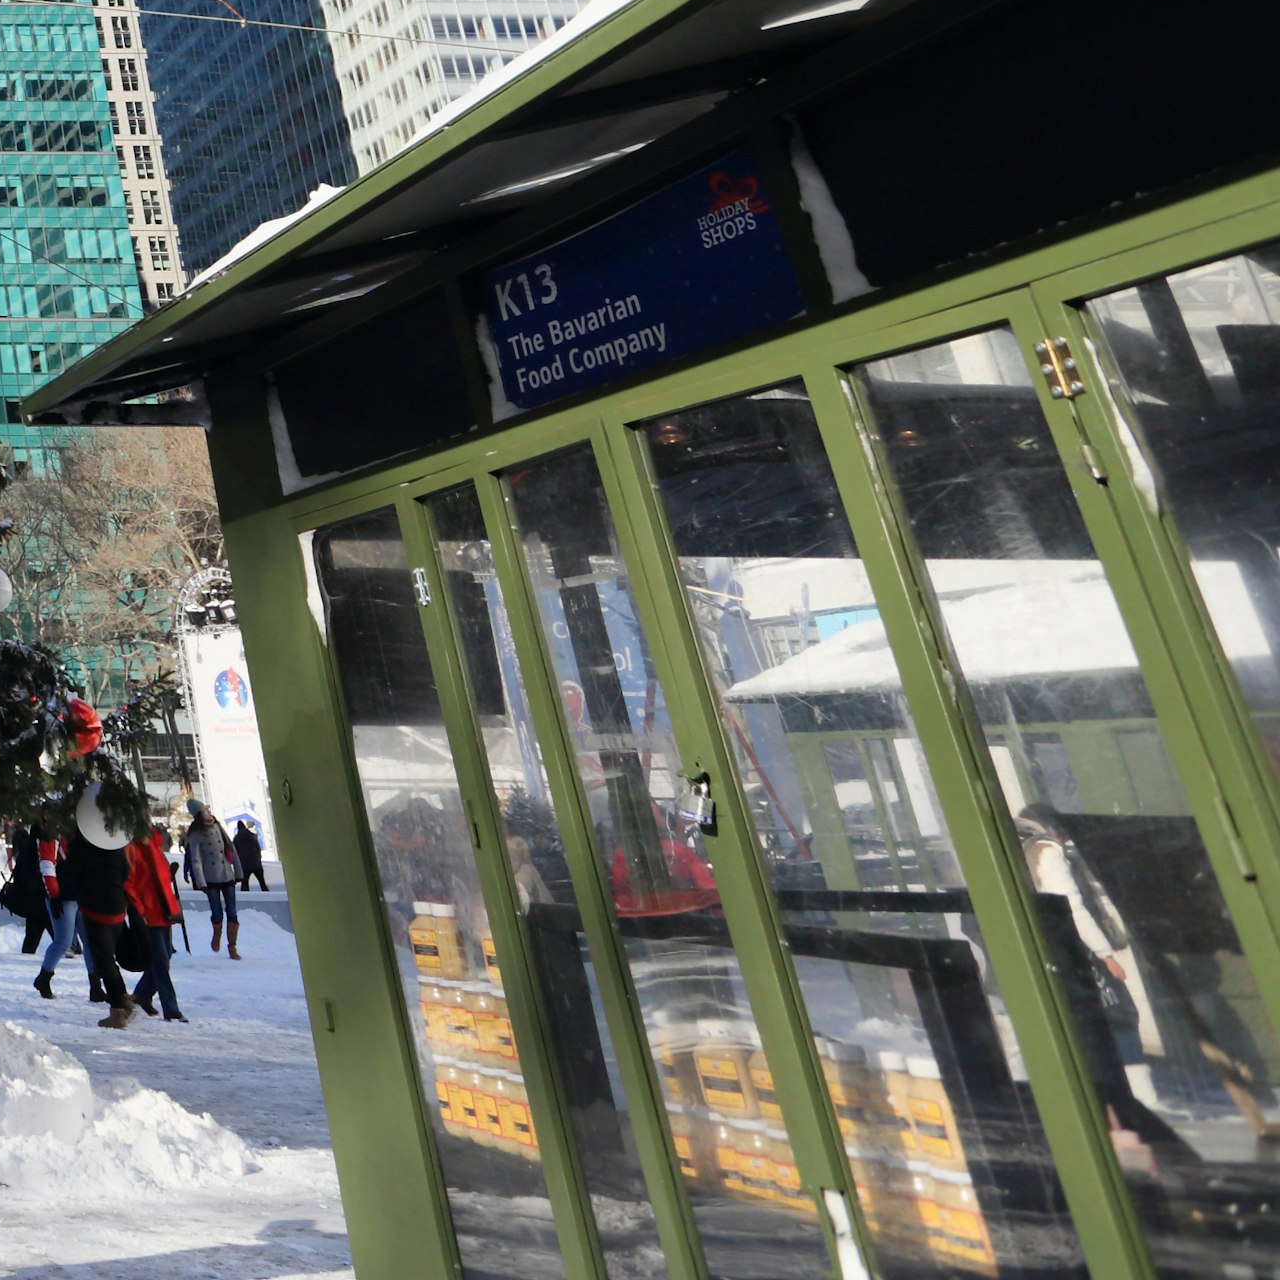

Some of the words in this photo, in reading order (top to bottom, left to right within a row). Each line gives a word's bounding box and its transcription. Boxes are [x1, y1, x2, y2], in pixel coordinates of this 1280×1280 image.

[696, 196, 752, 231] HOLIDAY
[701, 212, 757, 249] SHOPS
[495, 263, 559, 322] K13
[508, 332, 546, 360] The
[548, 293, 642, 347] Bavarian
[516, 354, 565, 393] Food
[569, 322, 667, 375] Company
